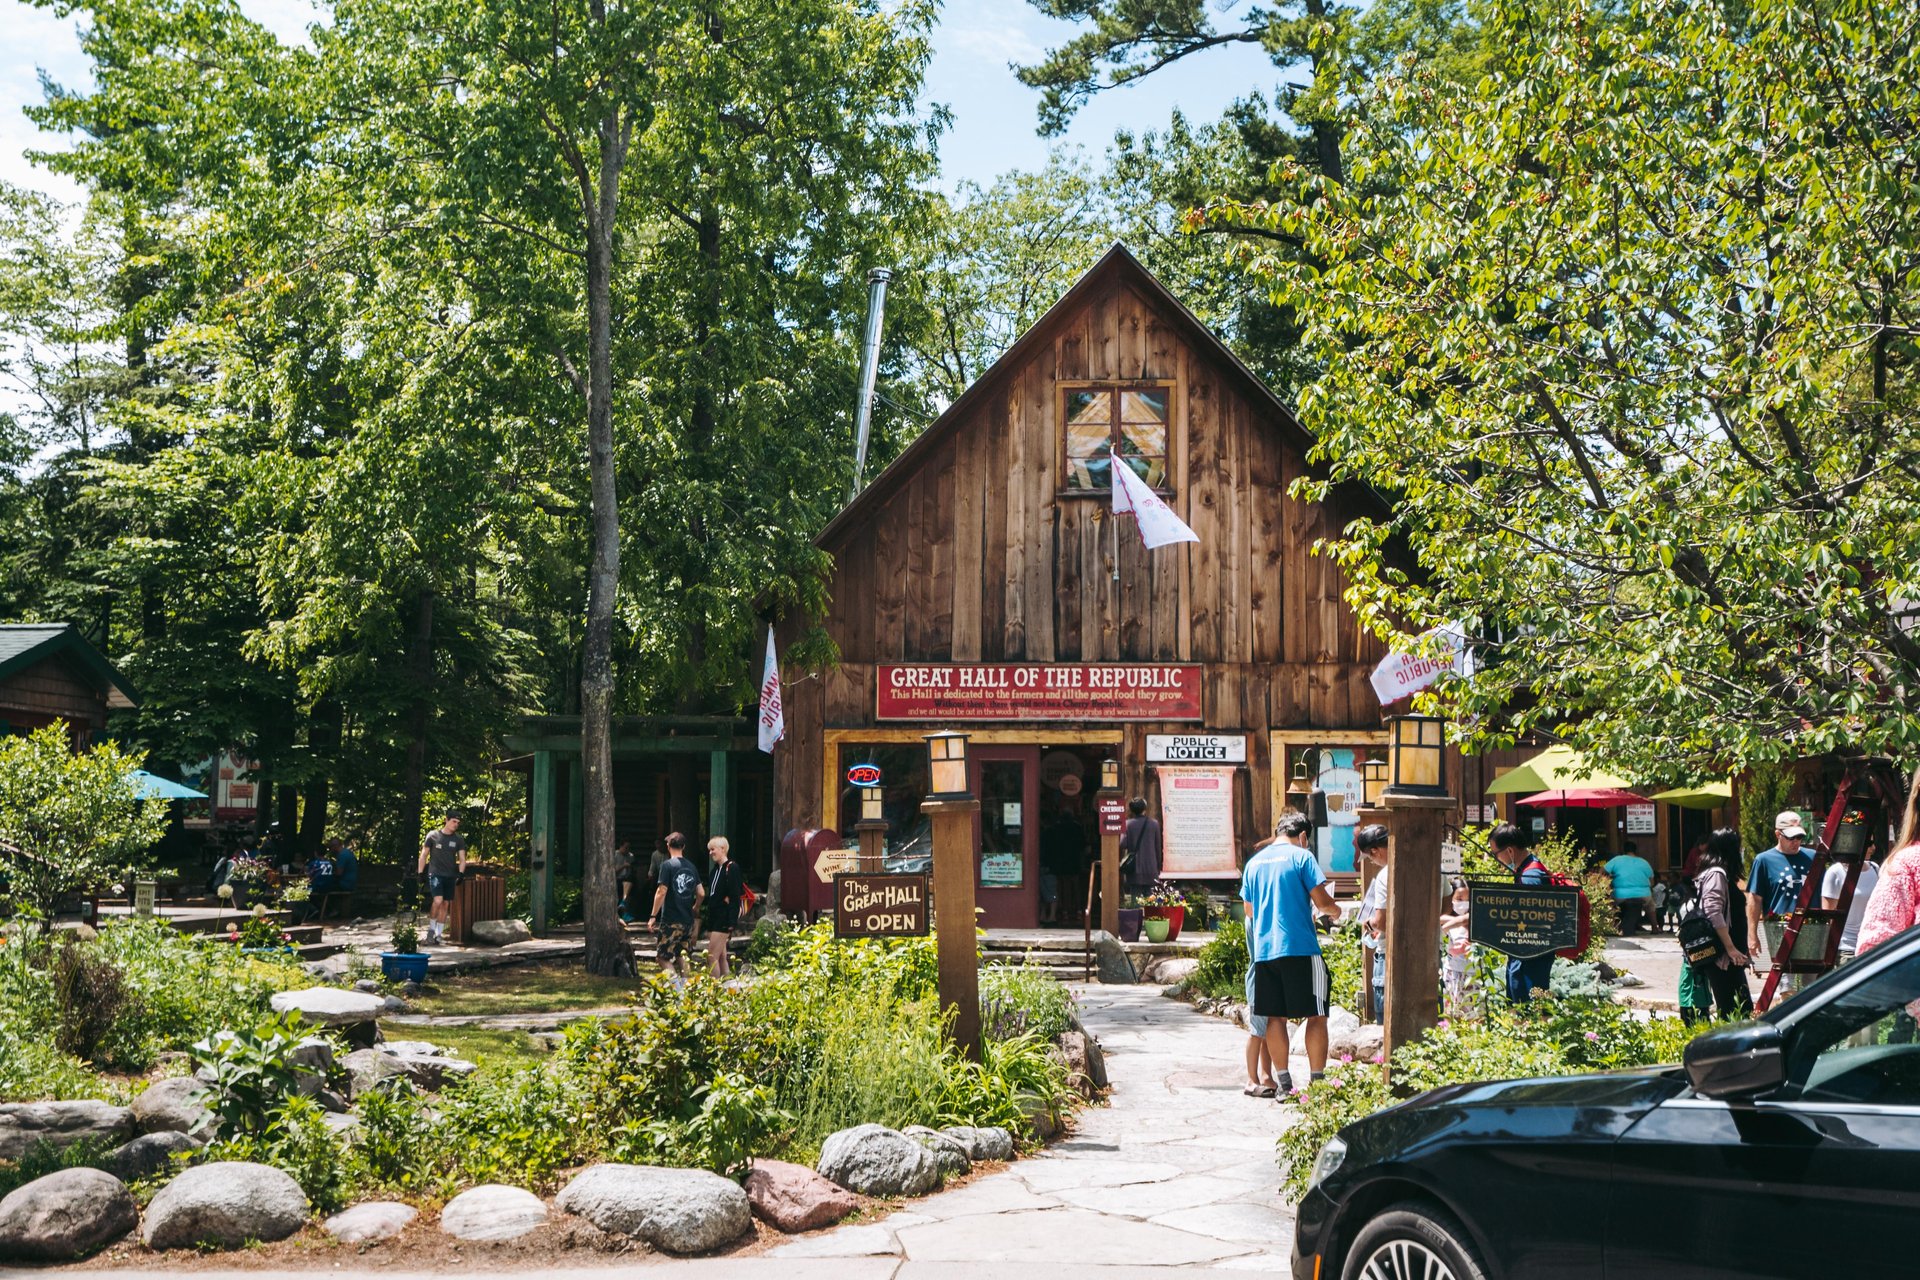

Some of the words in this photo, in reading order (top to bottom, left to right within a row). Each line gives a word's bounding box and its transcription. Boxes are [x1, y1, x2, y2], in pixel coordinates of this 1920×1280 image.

[890, 667, 953, 688] GREAT
[959, 667, 1009, 688] HALL
[1013, 667, 1040, 688] OF
[1044, 667, 1083, 688] THE
[1088, 667, 1182, 688] REPUBLIC
[890, 688, 910, 700] This
[912, 688, 932, 699] Hall
[934, 688, 942, 699] is
[943, 688, 983, 700] dedicated
[985, 689, 995, 699] to
[996, 688, 1010, 699] the
[1011, 688, 1044, 700] farmers
[1045, 688, 1061, 700] and
[1090, 688, 1113, 701] good
[1114, 688, 1135, 700] food
[1137, 688, 1156, 702] they
[938, 707, 956, 716] would
[957, 707, 965, 715] be
[984, 707, 995, 716] the
[1173, 737, 1218, 746] PUBLIC
[1168, 747, 1223, 758] NOTICE
[848, 769, 880, 781] OPEN
[822, 863, 841, 873] WINE
[845, 881, 869, 894] The
[844, 891, 884, 913] GREAT
[885, 886, 921, 909] HALL
[1476, 895, 1515, 905] CHERRY
[1518, 897, 1572, 909] REPUBLIC
[1489, 908, 1557, 922] CUSTOMS
[866, 914, 915, 931] OPEN
[1505, 931, 1538, 939] DECLARE
[1517, 938, 1550, 946] BANANAS
